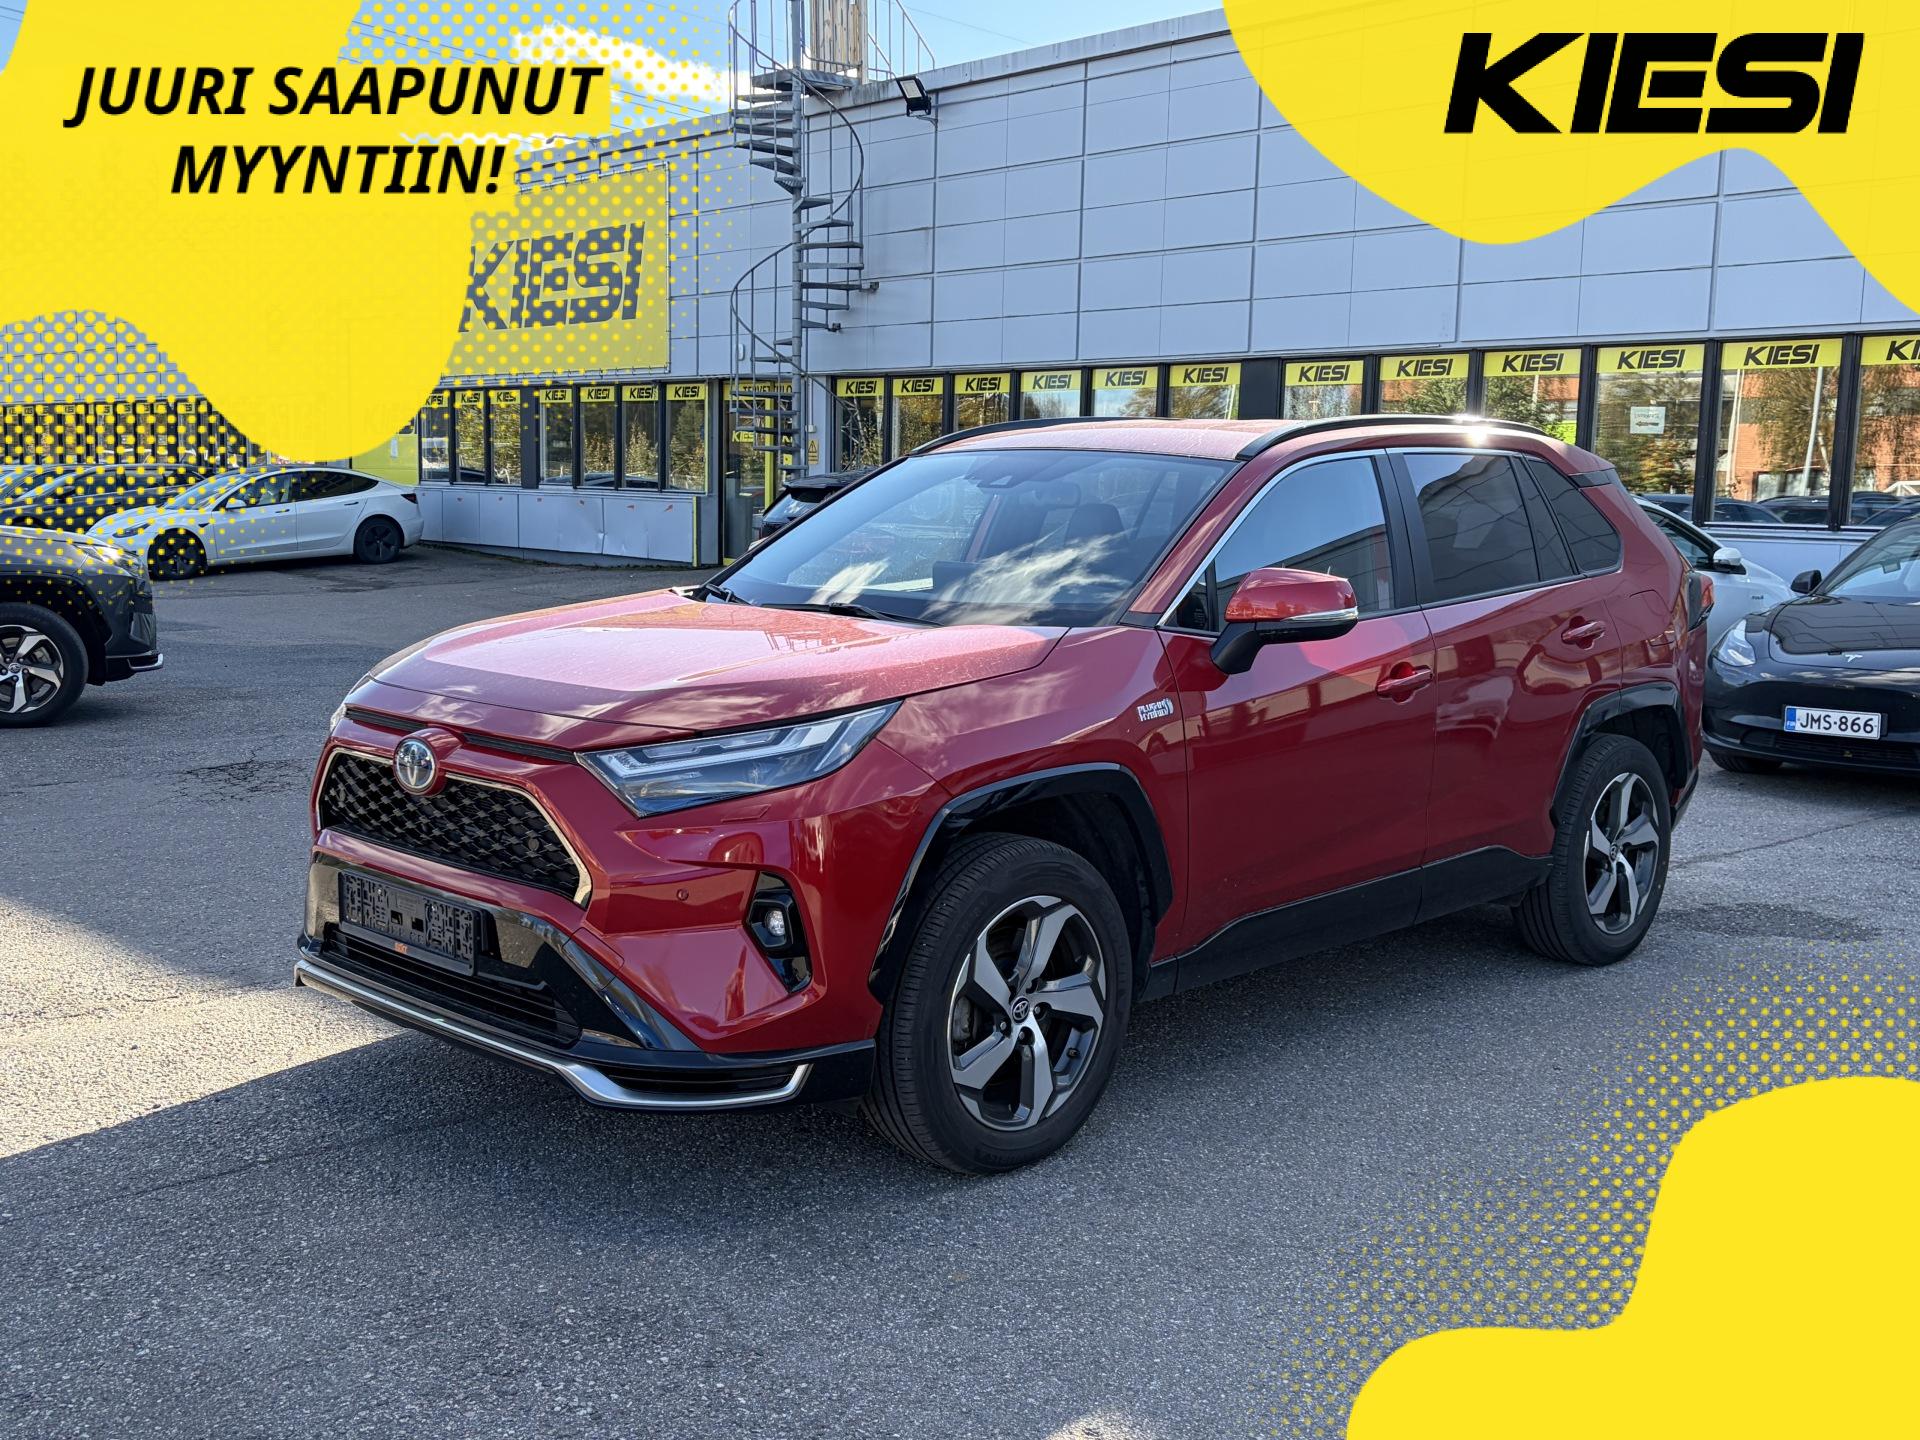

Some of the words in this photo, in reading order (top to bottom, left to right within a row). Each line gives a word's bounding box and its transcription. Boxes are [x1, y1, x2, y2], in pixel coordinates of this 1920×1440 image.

[458, 221, 646, 332] KIESI
[1744, 344, 1820, 366] KIESI
[1886, 340, 1920, 360] KI
[1502, 353, 1564, 373] KIESI
[1617, 349, 1686, 369] KIESI
[1183, 367, 1228, 383] KIESI
[1298, 364, 1350, 382] KIESI
[1396, 358, 1453, 377] KIESI
[901, 379, 935, 392] KIESI
[965, 377, 1001, 391] KIESI
[1033, 374, 1072, 389] KIESI
[1105, 370, 1147, 386] KIESI
[545, 389, 566, 400] KIESI
[587, 386, 610, 399] KIESI
[629, 386, 654, 399] KIESI
[674, 386, 700, 398] KIESI
[845, 381, 877, 394] KIESI
[497, 391, 516, 402] KIES
[732, 430, 754, 443] KIES
[1800, 712, 1874, 734] JMS-866
